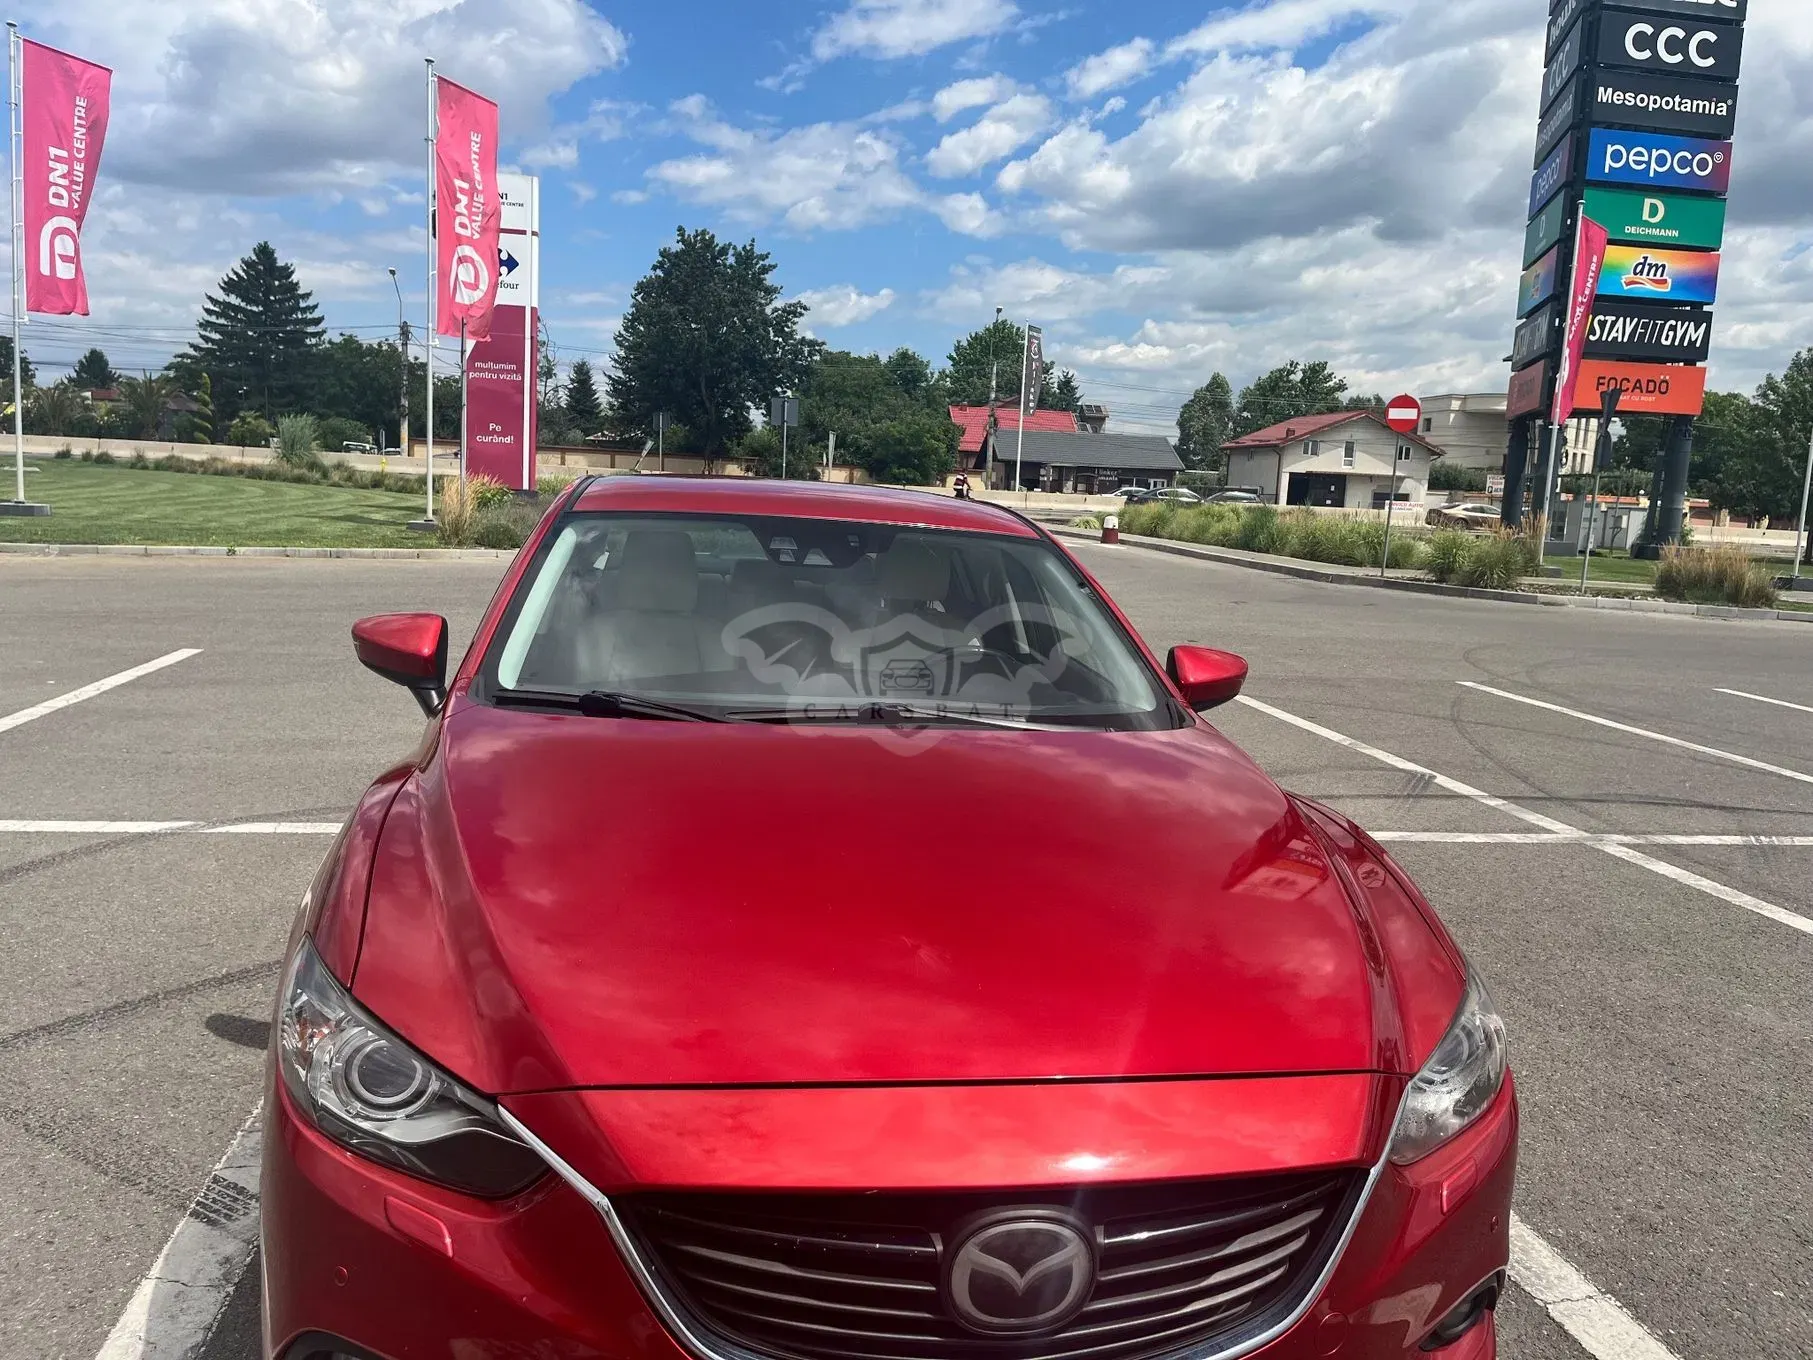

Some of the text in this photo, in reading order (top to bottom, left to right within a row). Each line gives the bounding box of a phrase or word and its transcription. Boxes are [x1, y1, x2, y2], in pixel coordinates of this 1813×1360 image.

[1624, 22, 1719, 68] CCC
[1597, 86, 1728, 116] Mesopotamia
[71, 95, 88, 210] VALUE CENTRE
[1604, 143, 1714, 177] pepco
[48, 145, 70, 208] DN1
[470, 130, 485, 240] VALUE CENTRE
[454, 178, 472, 238] DN1
[498, 192, 508, 200] N1
[1641, 198, 1665, 223] D
[1624, 225, 1680, 238] DEICHMANN
[1632, 256, 1667, 278] dm
[469, 371, 498, 380] pentru
[476, 434, 514, 444] curând!
[489, 423, 502, 432] Pe
